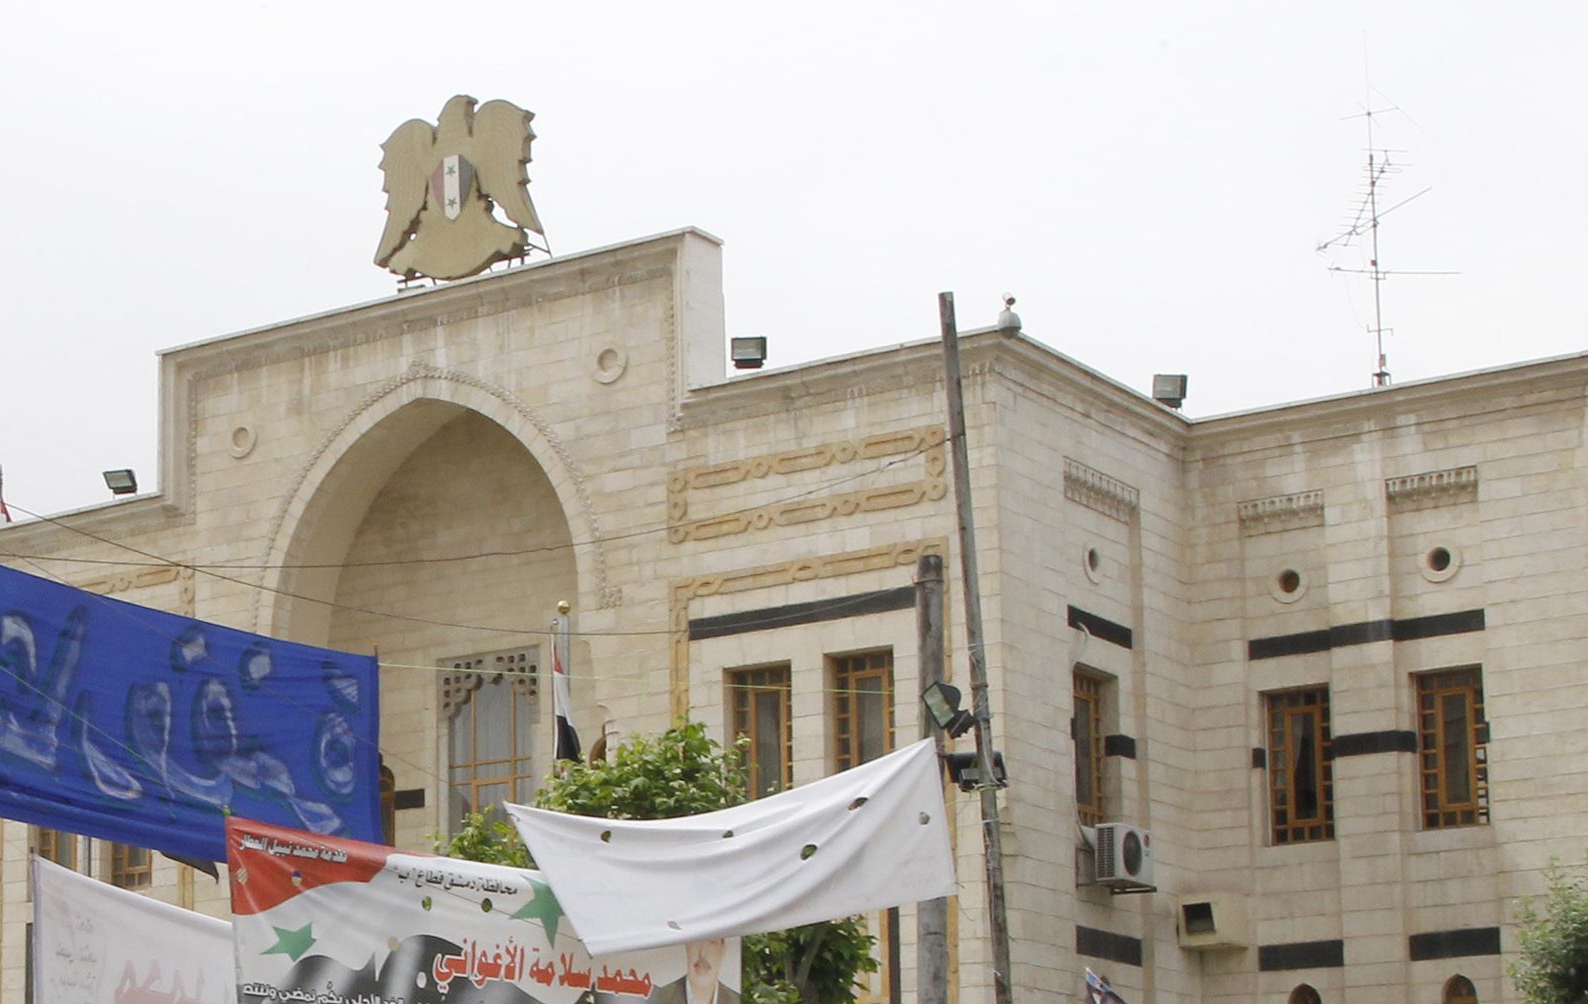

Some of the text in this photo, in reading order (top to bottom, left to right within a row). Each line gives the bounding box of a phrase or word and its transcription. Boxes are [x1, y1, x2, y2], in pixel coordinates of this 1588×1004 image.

[293, 844, 320, 860] محمد
[444, 872, 476, 891] دمشق
[432, 936, 654, 998] محمد سلامة الأغواني
